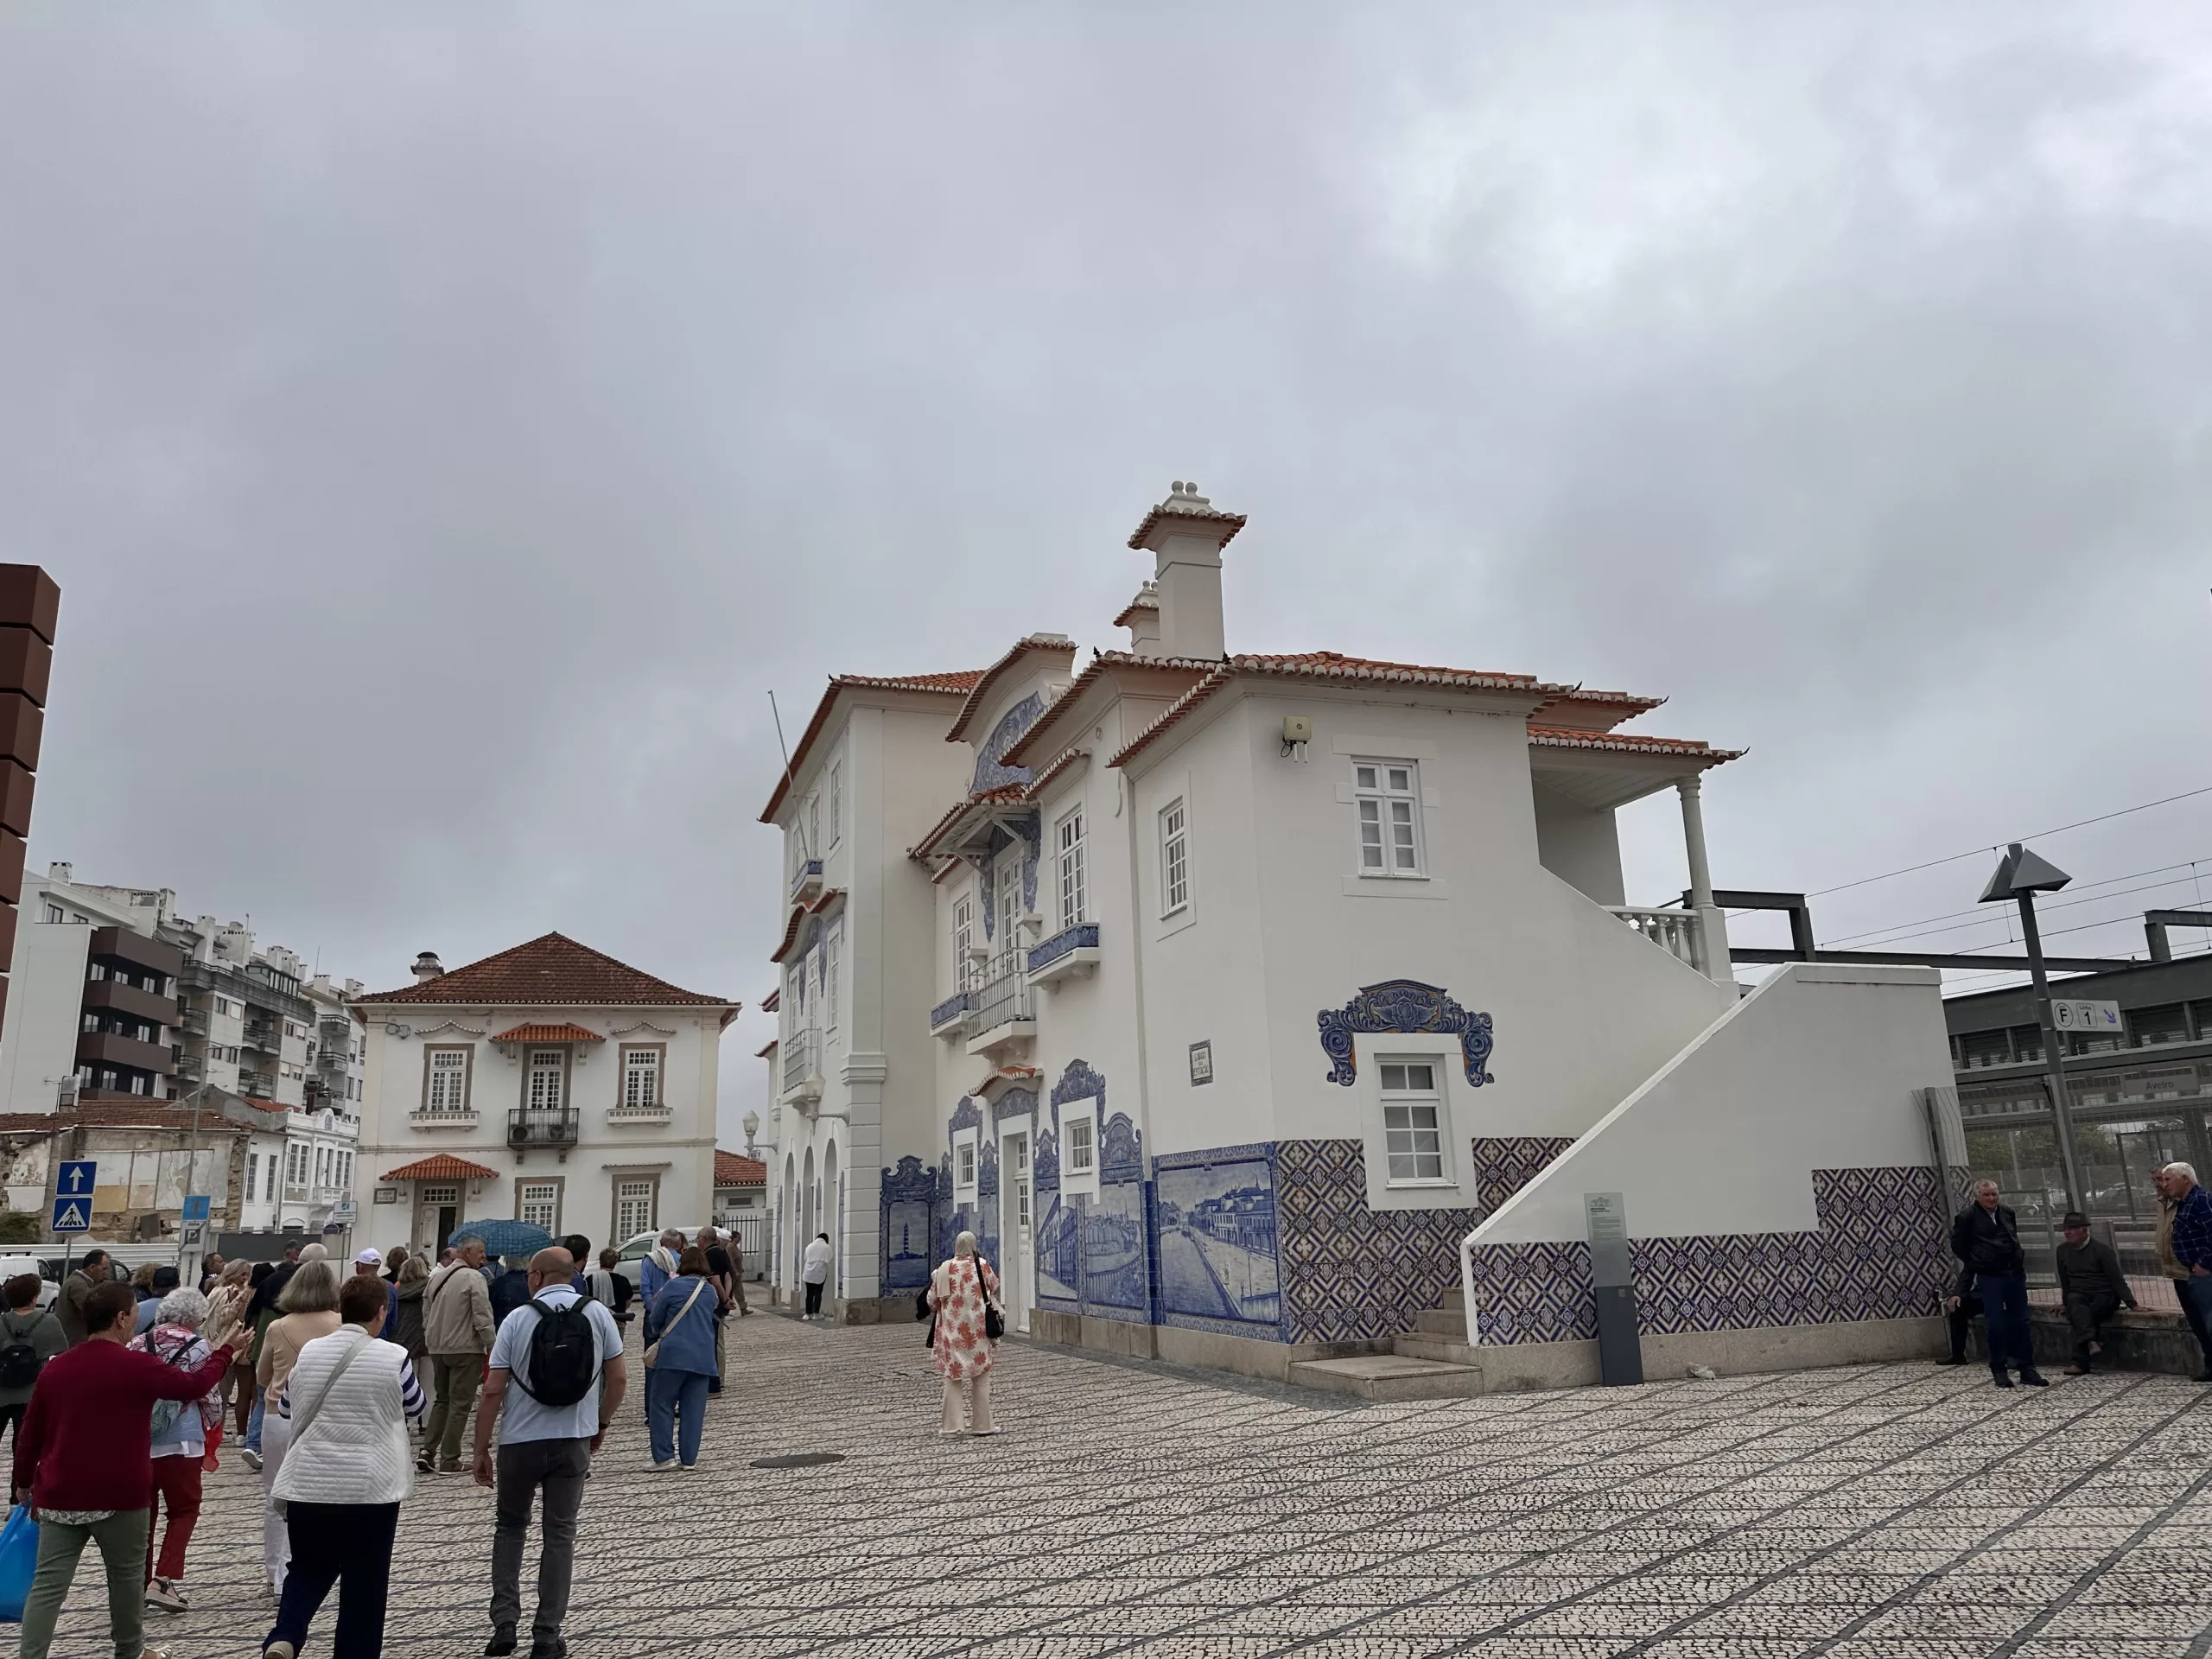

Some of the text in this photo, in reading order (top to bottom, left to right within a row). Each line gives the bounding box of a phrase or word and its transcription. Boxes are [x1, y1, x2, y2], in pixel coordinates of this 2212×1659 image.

[2059, 1008, 2068, 1022] F
[2084, 1011, 2091, 1026] 1
[2146, 1081, 2174, 1090] Aveiro
[188, 1230, 198, 1243] P
